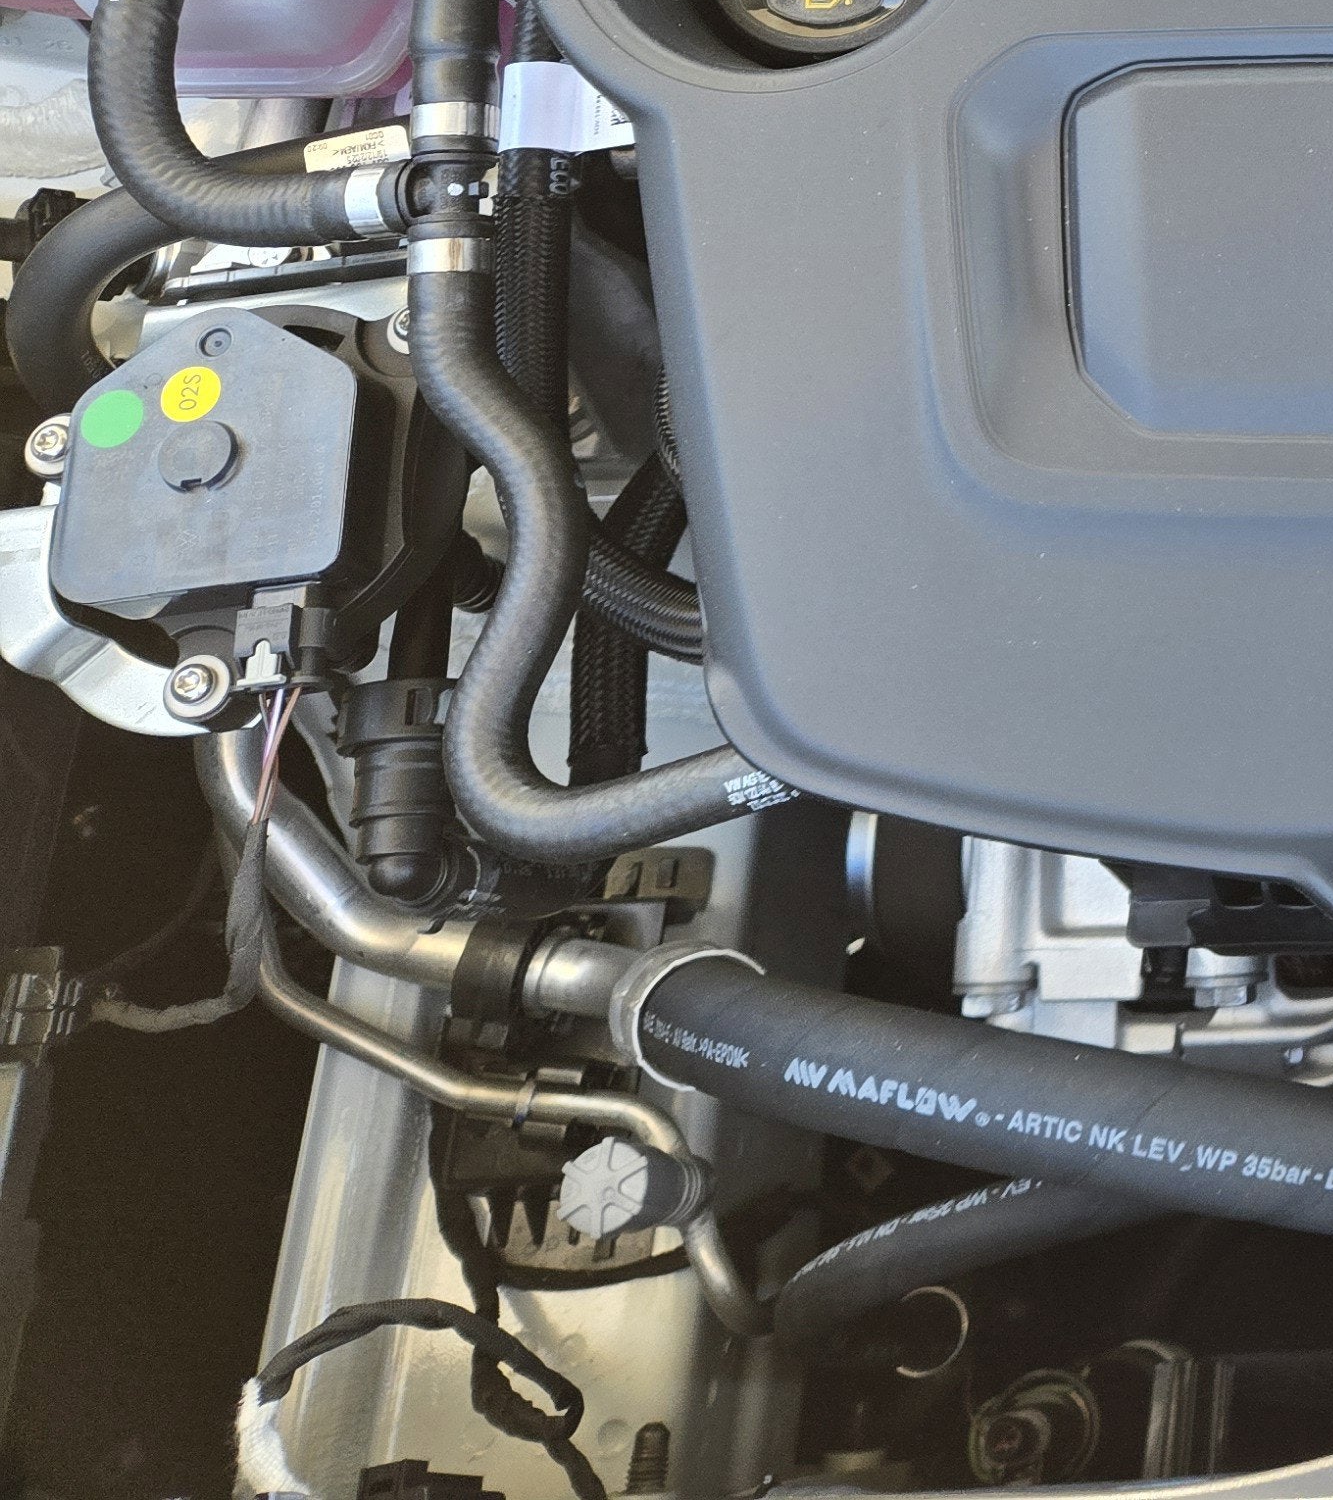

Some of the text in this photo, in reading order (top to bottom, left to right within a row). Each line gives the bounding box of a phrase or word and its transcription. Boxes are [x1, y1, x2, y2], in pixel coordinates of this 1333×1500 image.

[1005, 1104, 1085, 1145] ARTIC
[1086, 1121, 1130, 1153] NK
[1191, 1143, 1240, 1175] WP
[1239, 1153, 1313, 1190] 35bar
